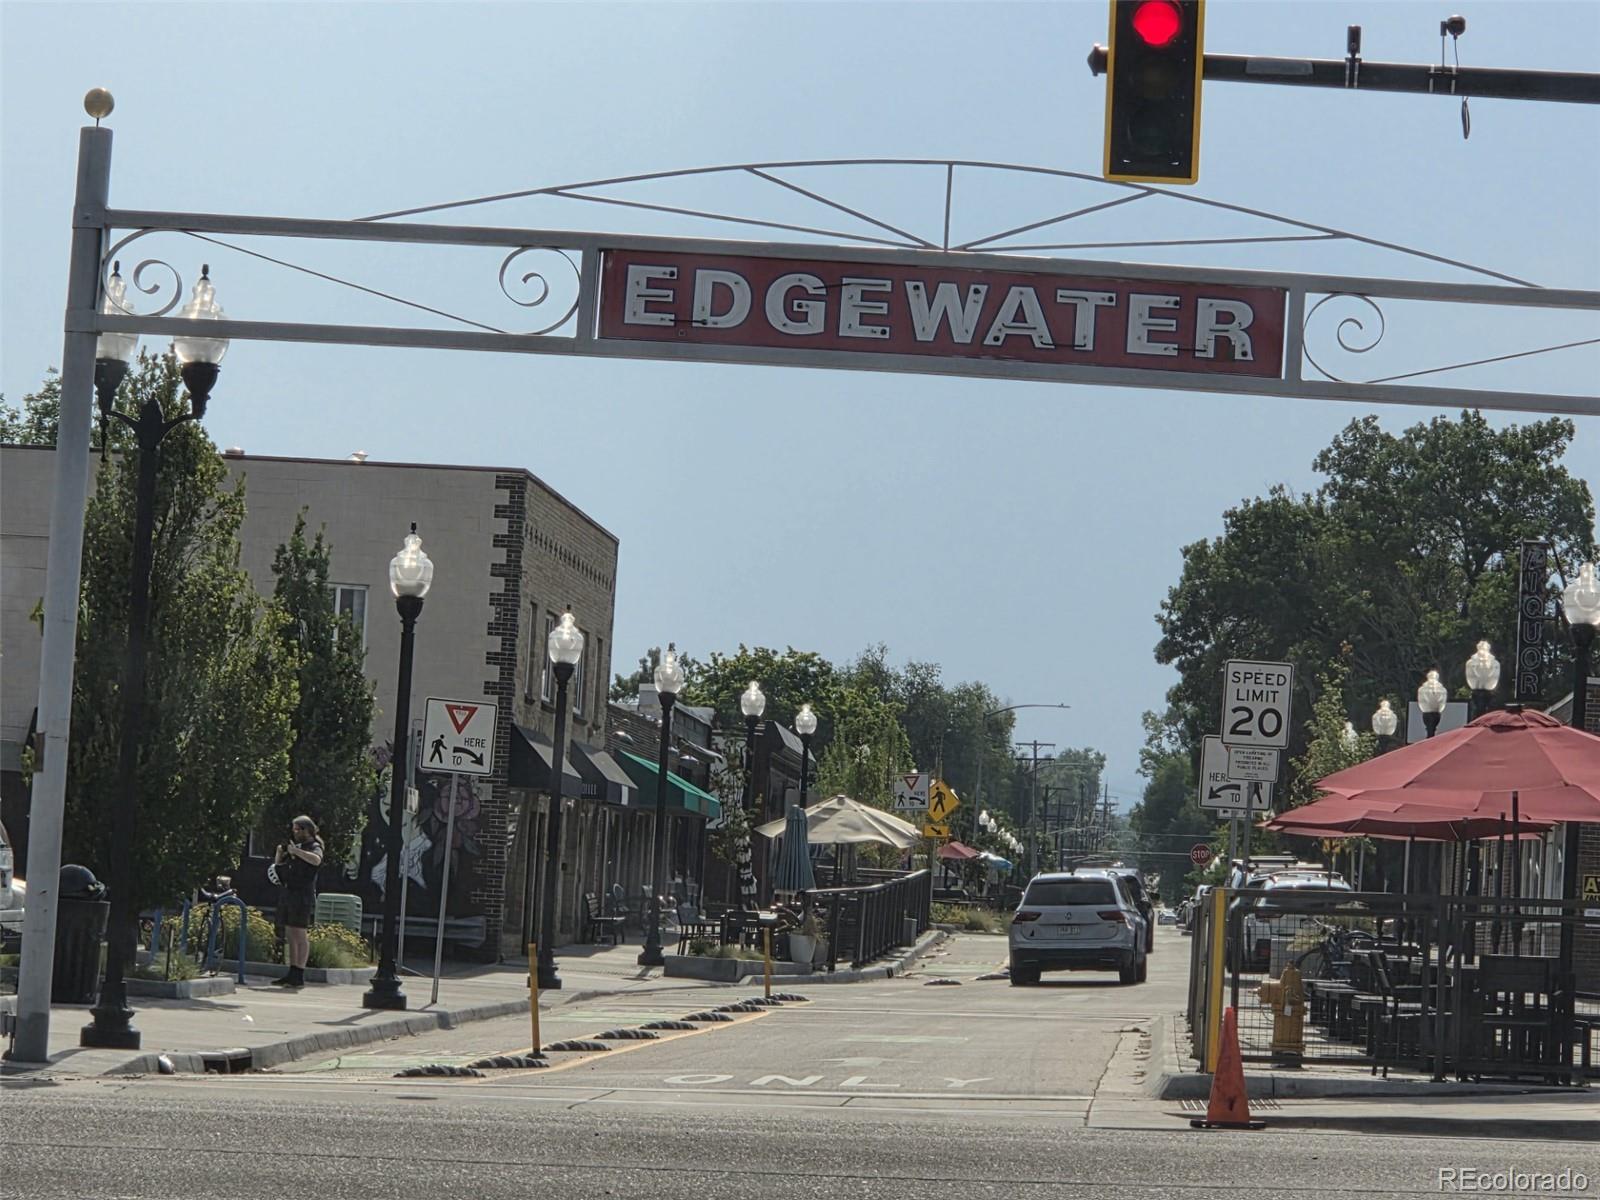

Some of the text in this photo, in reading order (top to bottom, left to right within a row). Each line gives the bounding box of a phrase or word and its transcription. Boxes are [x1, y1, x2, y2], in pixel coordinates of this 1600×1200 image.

[622, 263, 1256, 362] EDGEWATER
[1231, 671, 1287, 686] SPEED
[1236, 688, 1279, 703] LIMIT
[1229, 706, 1282, 737] 20
[463, 737, 486, 748] HERE
[452, 755, 462, 766] TO
[1230, 792, 1240, 803] TO
[1193, 850, 1210, 859] STOP
[663, 1074, 994, 1088] ONLY
